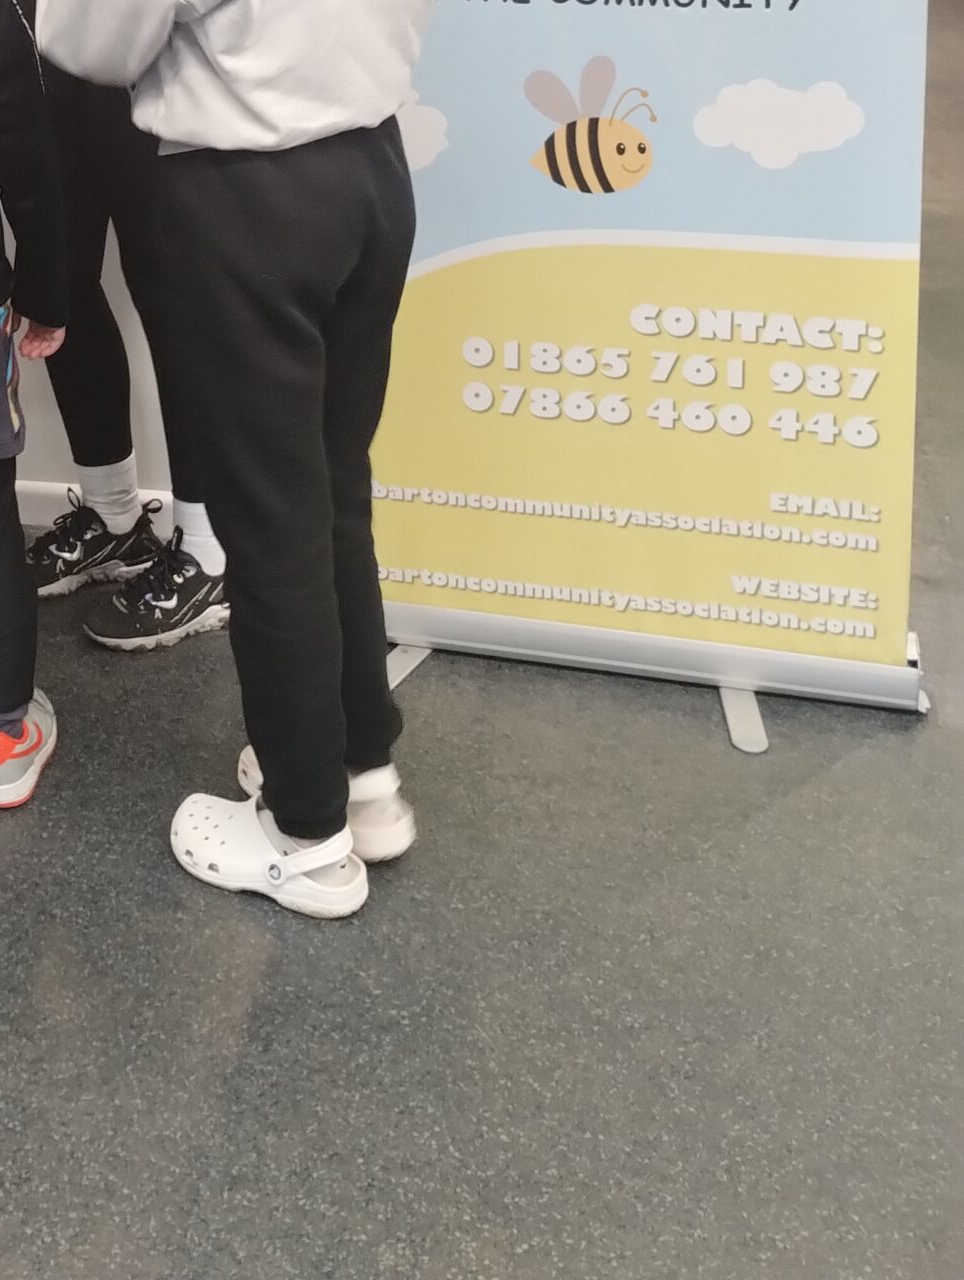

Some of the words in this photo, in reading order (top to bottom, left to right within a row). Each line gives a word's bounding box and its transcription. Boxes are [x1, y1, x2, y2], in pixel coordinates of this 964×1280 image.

[629, 303, 885, 354] CONTACT:
[462, 336, 631, 379] 01865
[650, 351, 745, 389] 761
[768, 361, 879, 401] 987
[462, 381, 631, 425] 07866
[646, 397, 753, 436] 460
[768, 408, 879, 449] 446
[770, 492, 881, 523] EMAIL:
[731, 574, 879, 611] WEBSITE:
